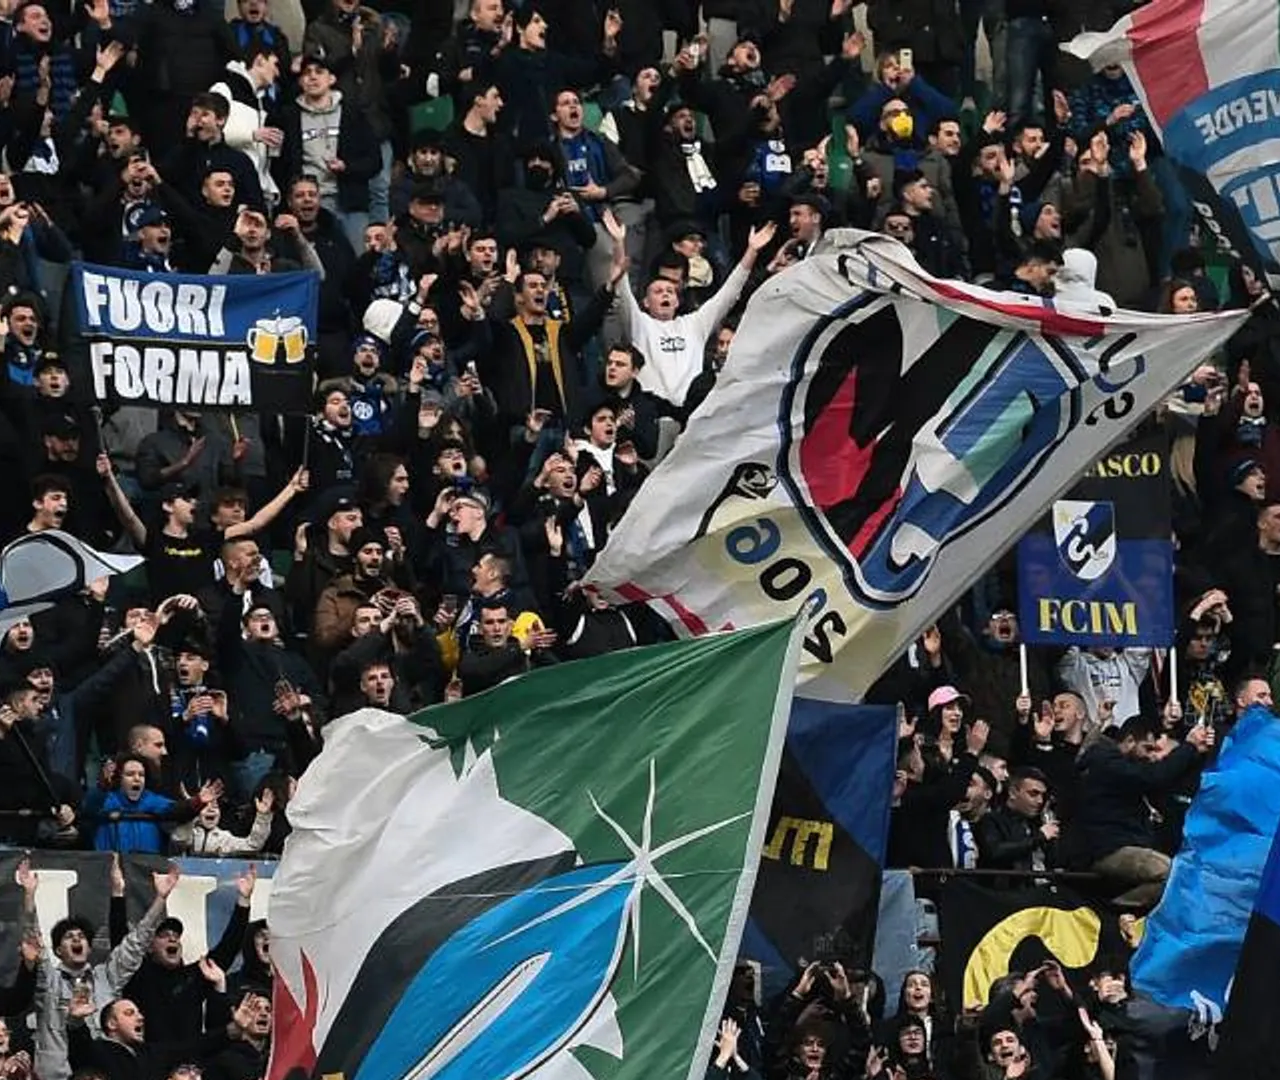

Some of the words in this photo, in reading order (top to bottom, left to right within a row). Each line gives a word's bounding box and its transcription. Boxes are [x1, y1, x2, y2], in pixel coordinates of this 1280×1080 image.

[82, 271, 226, 337] FUORI
[90, 342, 253, 405] FORMA
[1039, 598, 1138, 635] FCIM
